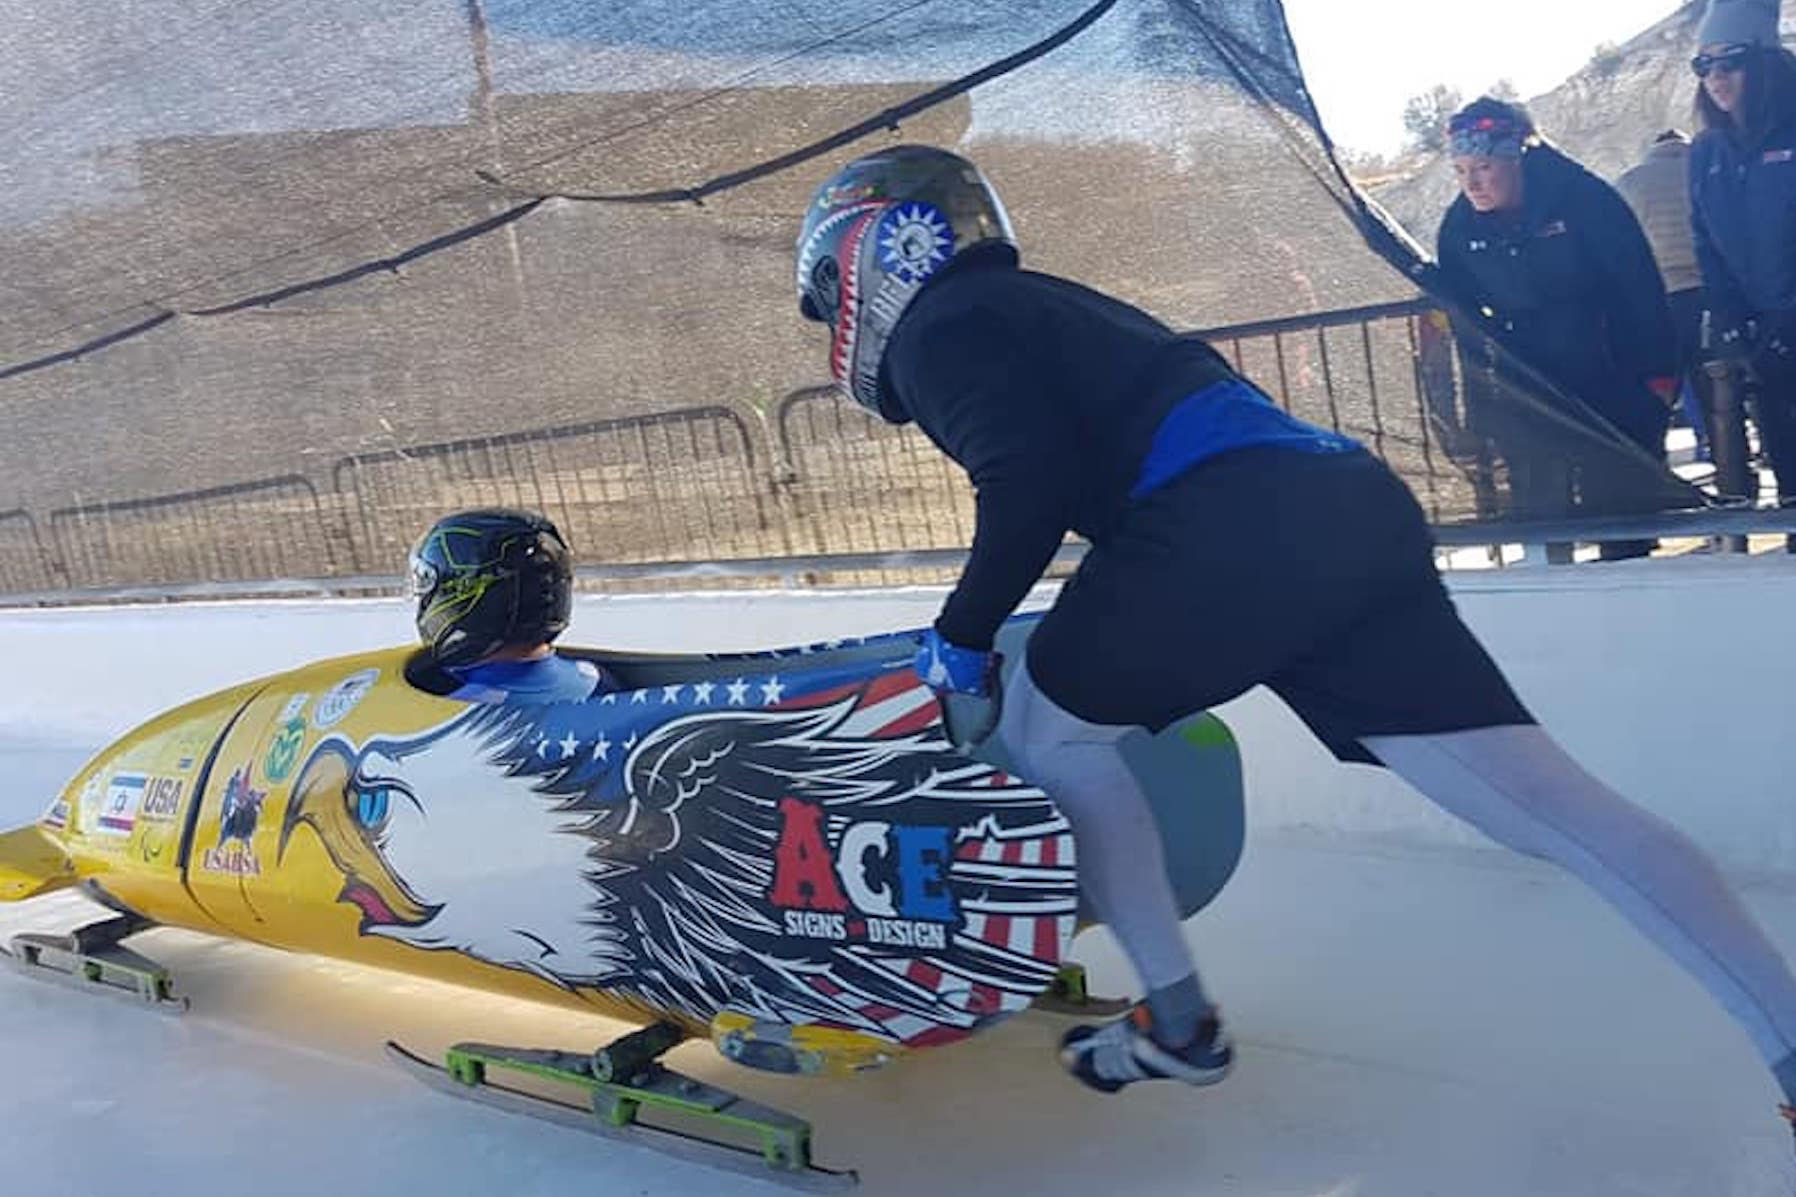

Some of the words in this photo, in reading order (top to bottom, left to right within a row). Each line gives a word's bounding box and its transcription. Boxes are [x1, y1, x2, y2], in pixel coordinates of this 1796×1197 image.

[144, 777, 182, 814] USA
[769, 797, 957, 922] ACE
[784, 911, 847, 940] SIGNS
[865, 918, 946, 949] DESIGN
